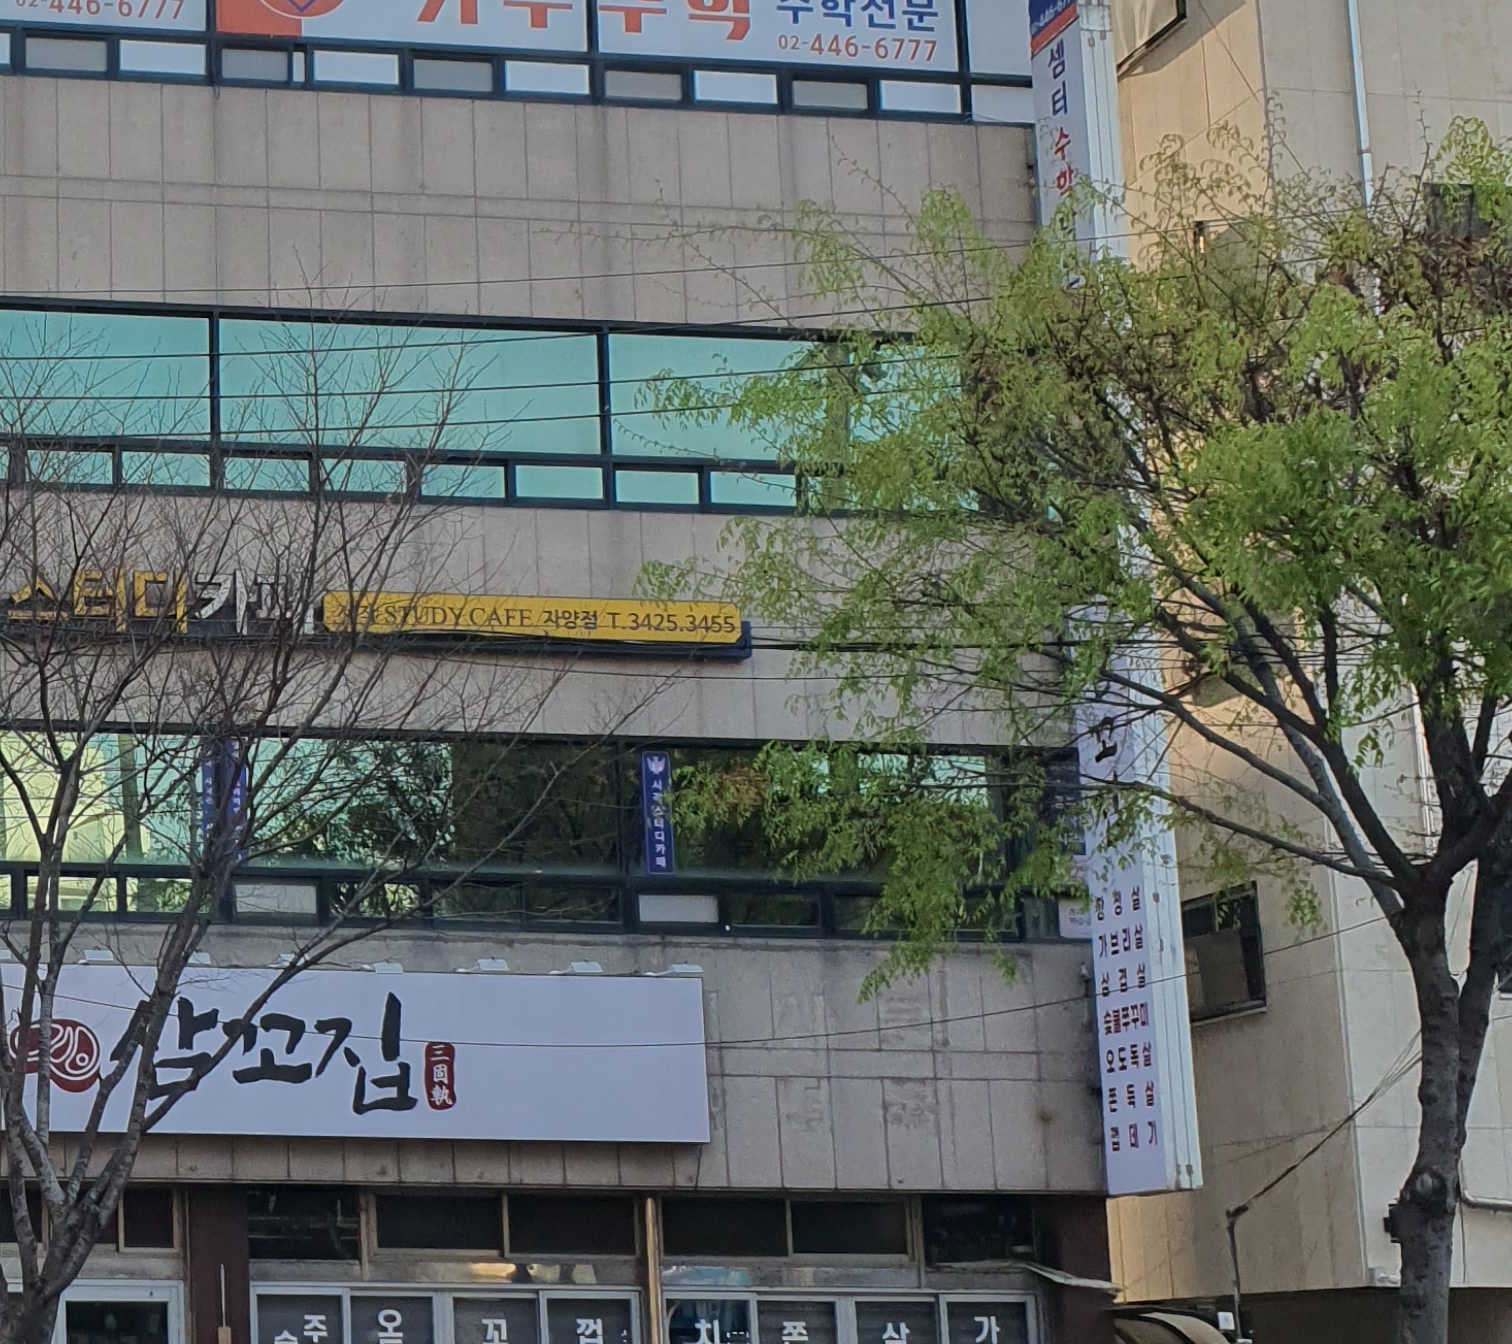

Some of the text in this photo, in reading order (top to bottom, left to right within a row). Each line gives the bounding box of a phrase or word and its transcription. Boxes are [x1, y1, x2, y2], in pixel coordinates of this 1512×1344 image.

[776, 32, 940, 64] 02-446-6777
[385, 605, 464, 626] STUDY
[470, 607, 533, 628] CAFE
[543, 609, 599, 631] 자양점
